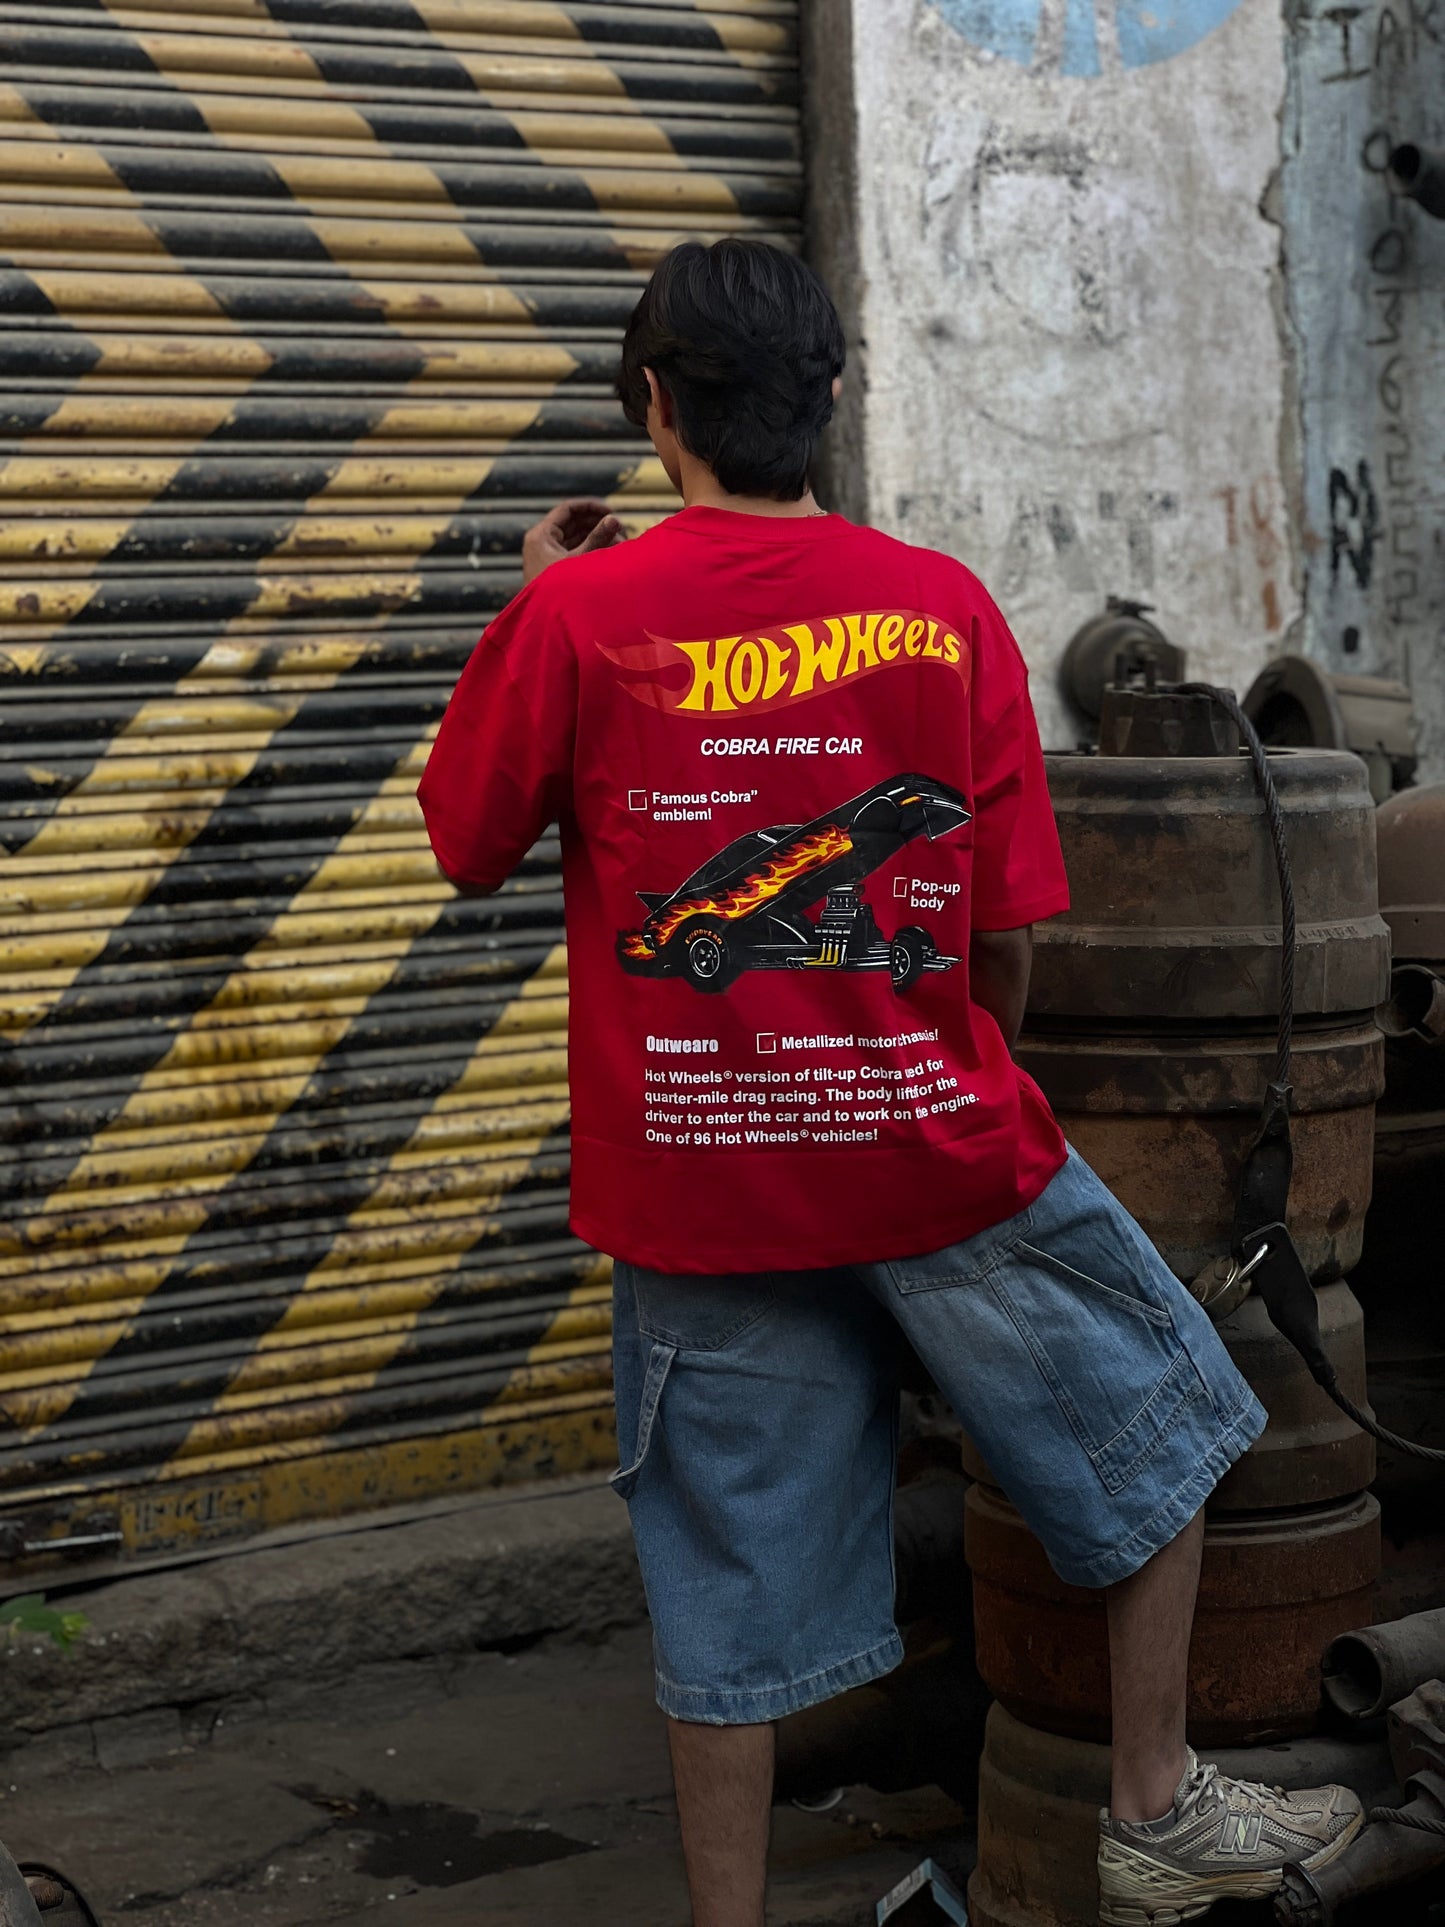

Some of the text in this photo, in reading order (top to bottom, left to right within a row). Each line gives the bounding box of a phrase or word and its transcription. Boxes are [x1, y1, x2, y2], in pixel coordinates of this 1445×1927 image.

[700, 737, 863, 756] COBRA FIRE CAR
[652, 792, 708, 805] Famous
[653, 808, 712, 822] emblem!
[911, 879, 960, 896] Pop-up
[910, 895, 945, 912] body
[646, 1035, 719, 1053] Outwearo
[781, 1034, 854, 1050] Metallized
[857, 1036, 898, 1049] motor
[645, 1068, 666, 1083] Hot
[735, 1071, 790, 1083] version
[794, 1069, 810, 1082] of
[813, 1067, 857, 1083] tilt-up
[860, 1066, 903, 1081] Cobra
[926, 1059, 944, 1073] for
[645, 1090, 729, 1105] quarter-mile
[733, 1090, 766, 1105] drag
[770, 1090, 821, 1106] racing.
[825, 1088, 853, 1101] The
[857, 1087, 893, 1102] body
[936, 1076, 958, 1092] the
[645, 1109, 684, 1125] driver
[687, 1112, 702, 1125] to
[706, 1111, 744, 1124] enter
[748, 1110, 771, 1123] the
[775, 1111, 799, 1123] car
[803, 1109, 831, 1123] and
[834, 1109, 850, 1122] to
[854, 1107, 890, 1121] work
[893, 1109, 912, 1121] on
[931, 1092, 980, 1115] engine.
[646, 1129, 672, 1143] One
[676, 1132, 690, 1144] of
[694, 1132, 711, 1145] 96
[715, 1131, 742, 1145] Hot
[812, 1128, 878, 1142] vehicles!
[1216, 1811, 1264, 1854] N
